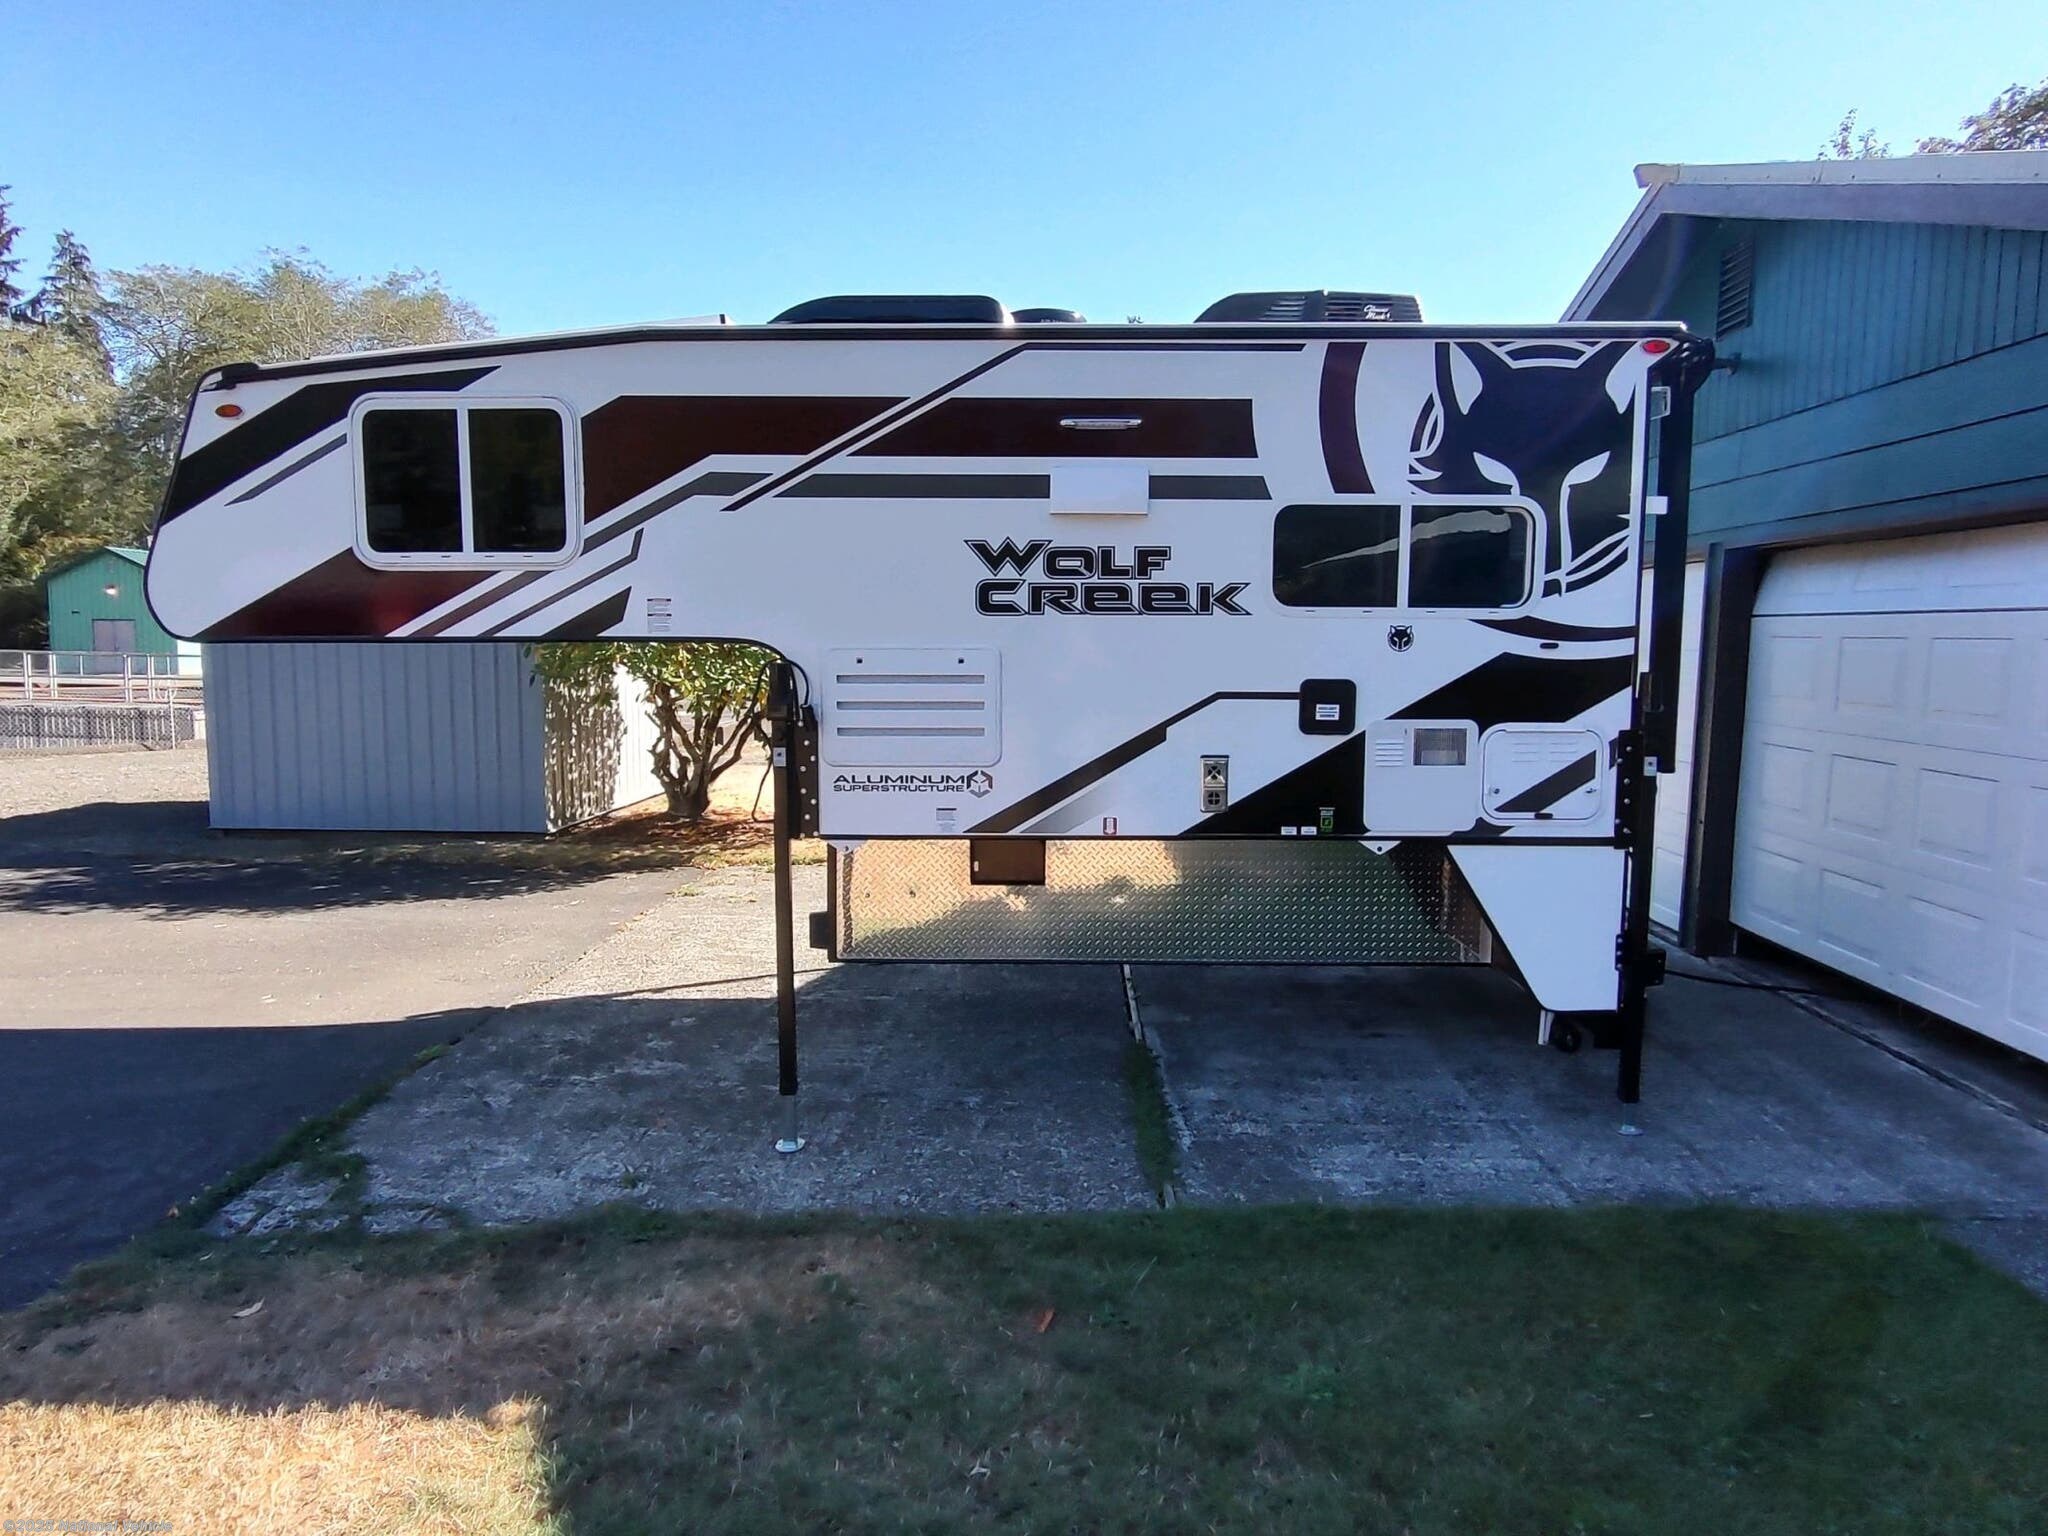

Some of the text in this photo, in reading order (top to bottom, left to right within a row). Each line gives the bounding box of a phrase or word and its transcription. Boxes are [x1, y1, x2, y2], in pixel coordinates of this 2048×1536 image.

[963, 536, 1172, 580] WOLF
[833, 774, 965, 784] ALUMINUM
[833, 784, 965, 793] SUPERSTRUCTURE
